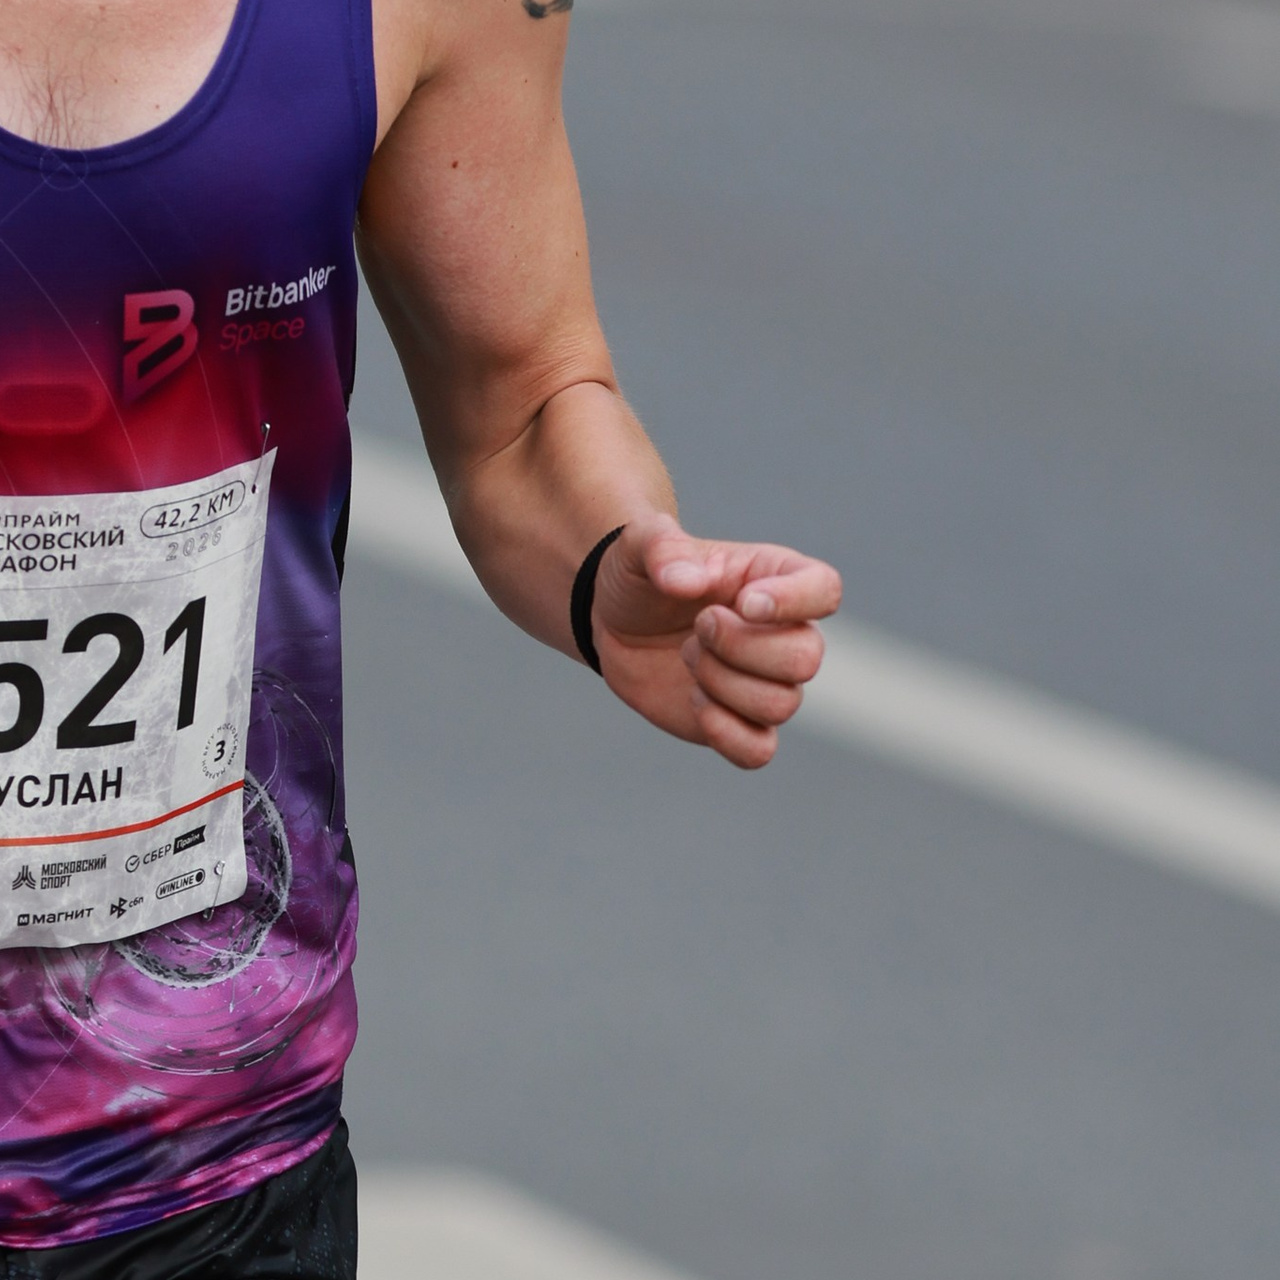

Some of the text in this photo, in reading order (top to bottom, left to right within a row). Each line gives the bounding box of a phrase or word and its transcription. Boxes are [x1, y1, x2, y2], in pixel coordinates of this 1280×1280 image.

[225, 265, 336, 317] Bitbanker
[220, 316, 306, 355] Space
[154, 503, 200, 529] 42,2
[213, 740, 226, 762] 3
[143, 833, 201, 865] СБЕР Прайм
[41, 854, 108, 876] МОСКОВСКИЙ
[40, 875, 72, 890] СПОРТ
[159, 874, 195, 896] WINLINE
[32, 907, 95, 925] магнит
